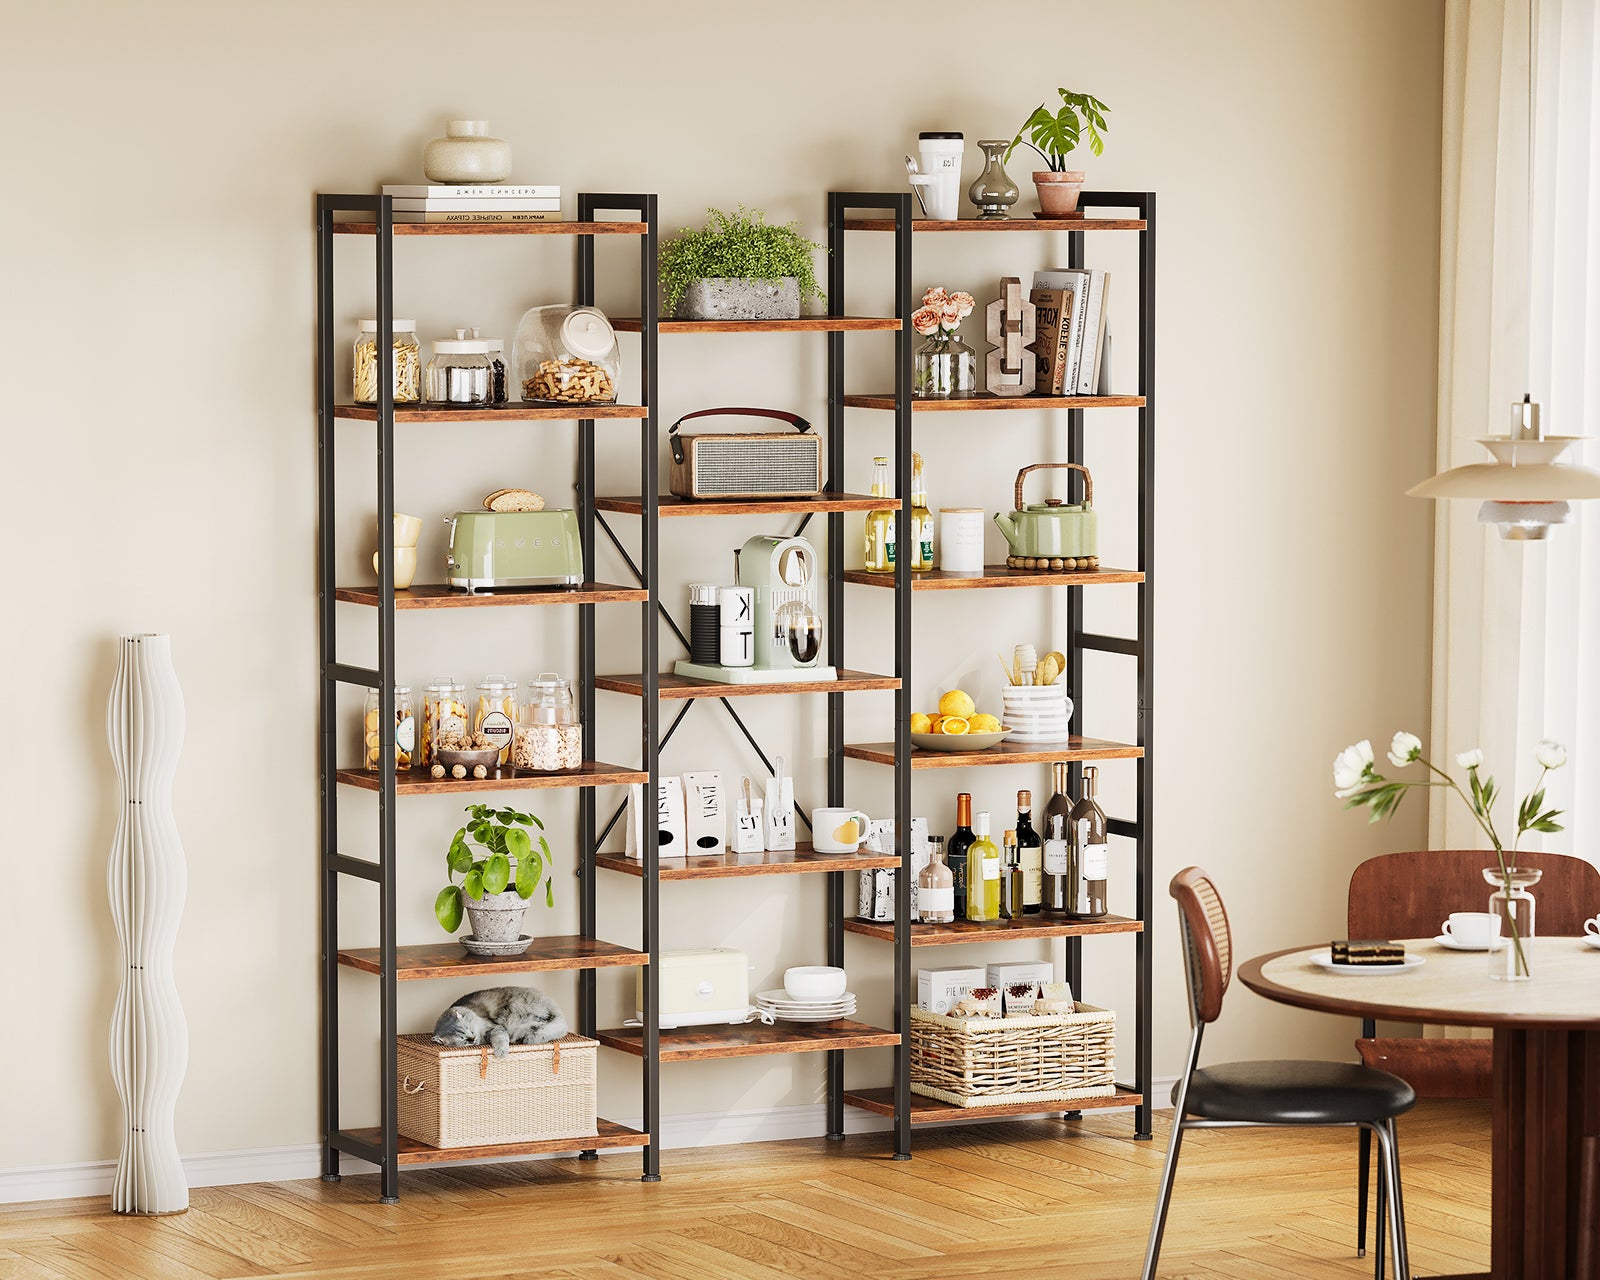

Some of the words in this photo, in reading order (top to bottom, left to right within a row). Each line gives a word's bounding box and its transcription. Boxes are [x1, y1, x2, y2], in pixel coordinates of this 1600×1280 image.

[496, 538, 561, 549] SMEG
[702, 786, 718, 818] PASTA
[945, 986, 956, 997] PIE
[959, 985, 972, 996] MI
